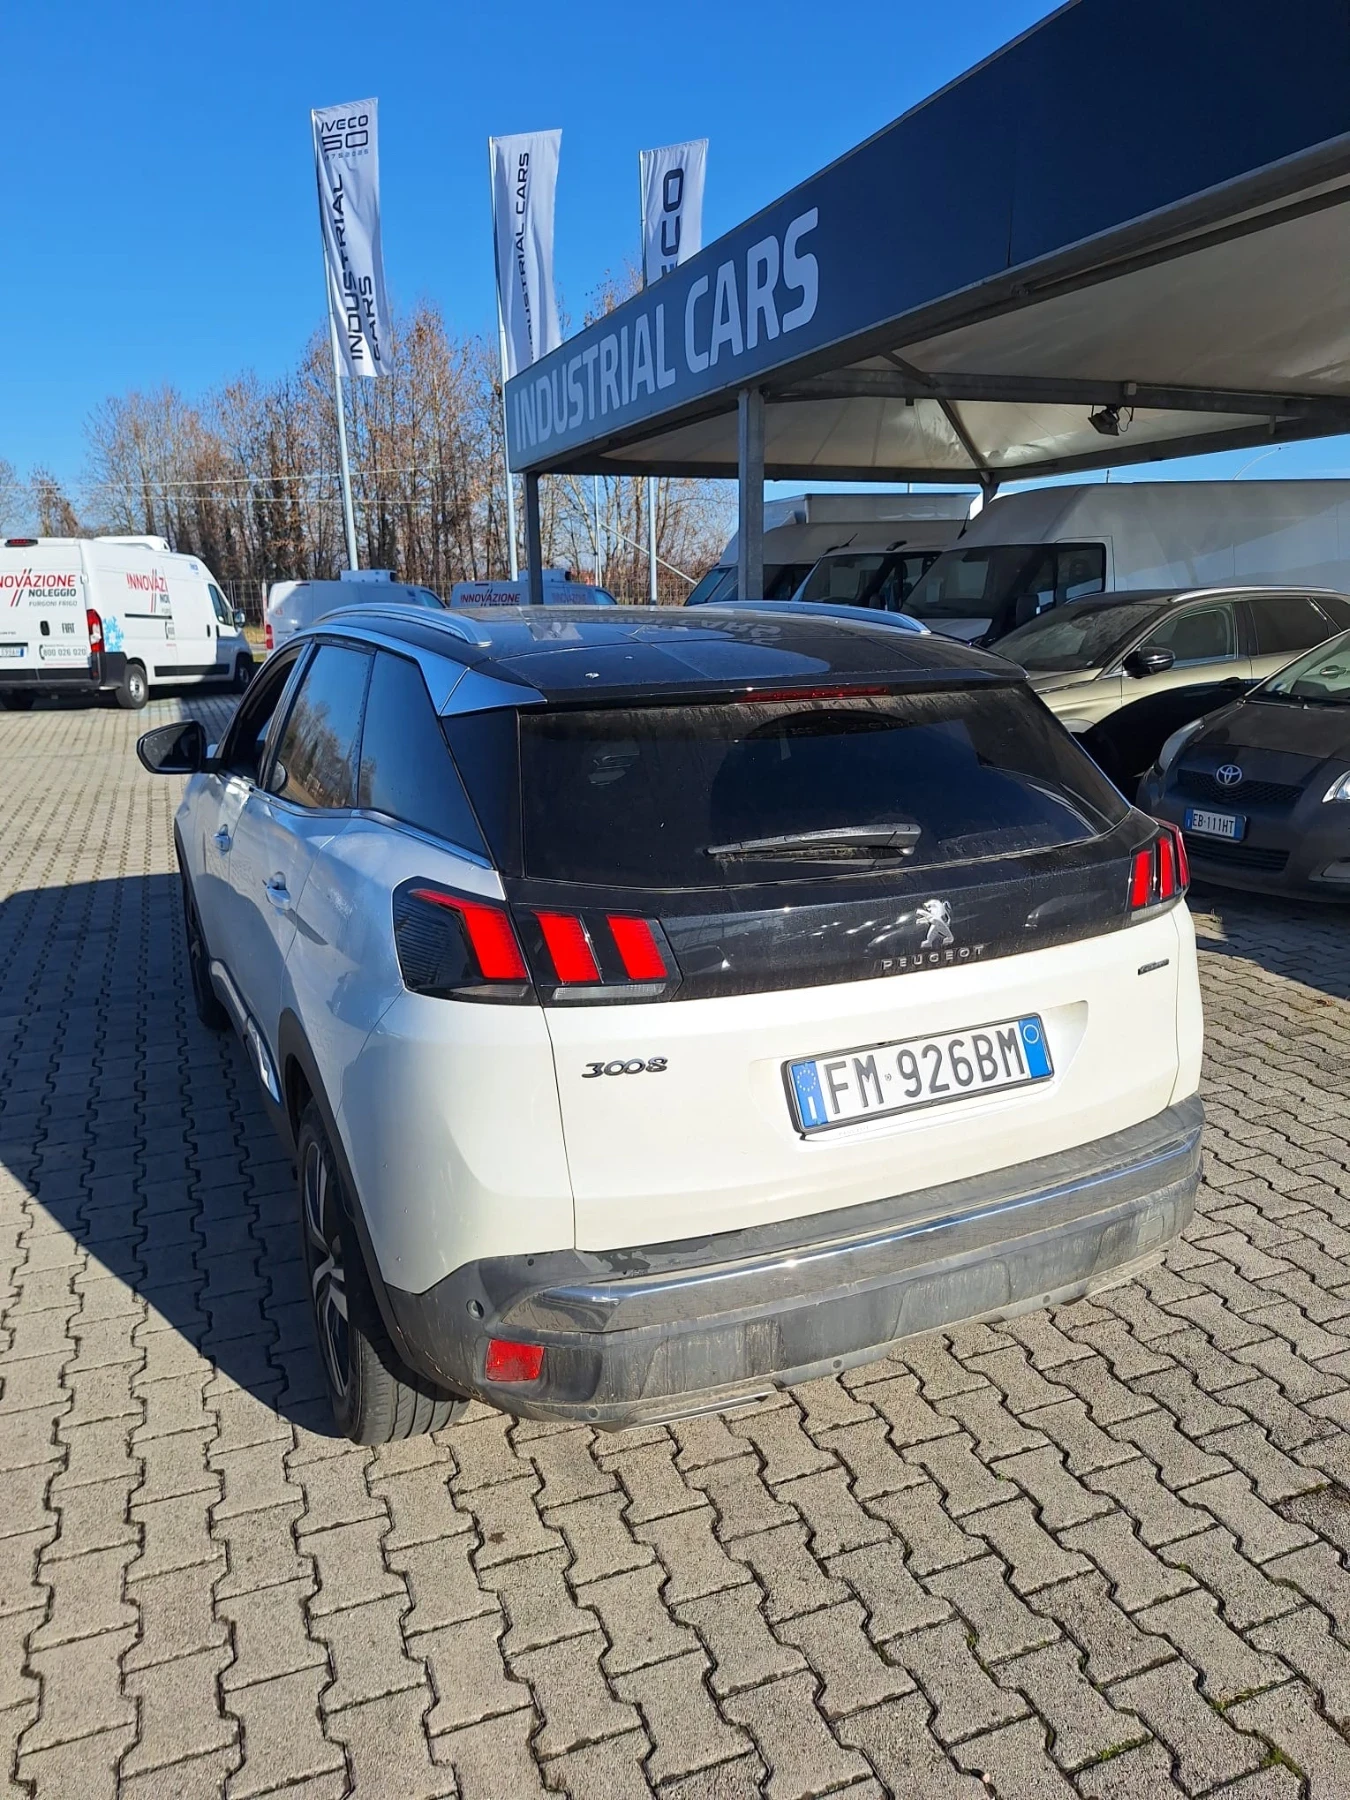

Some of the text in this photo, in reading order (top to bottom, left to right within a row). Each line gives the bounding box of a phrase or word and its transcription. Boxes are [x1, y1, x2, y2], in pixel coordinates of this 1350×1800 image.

[321, 114, 369, 134] IVECO
[321, 129, 368, 153] 50
[515, 152, 529, 215] CARS
[332, 173, 364, 360] INDUSTRIAL
[358, 275, 381, 361] CARS
[514, 206, 820, 452] INDUSTRIAL CARS
[28, 588, 77, 597] NOLEGGIO
[460, 592, 521, 604] INNOVAZIONE
[61, 622, 76, 634] FIAT
[881, 945, 986, 971] PEUGEOT
[581, 1056, 669, 1079] 3008
[823, 1027, 1026, 1115] FM 926BM
